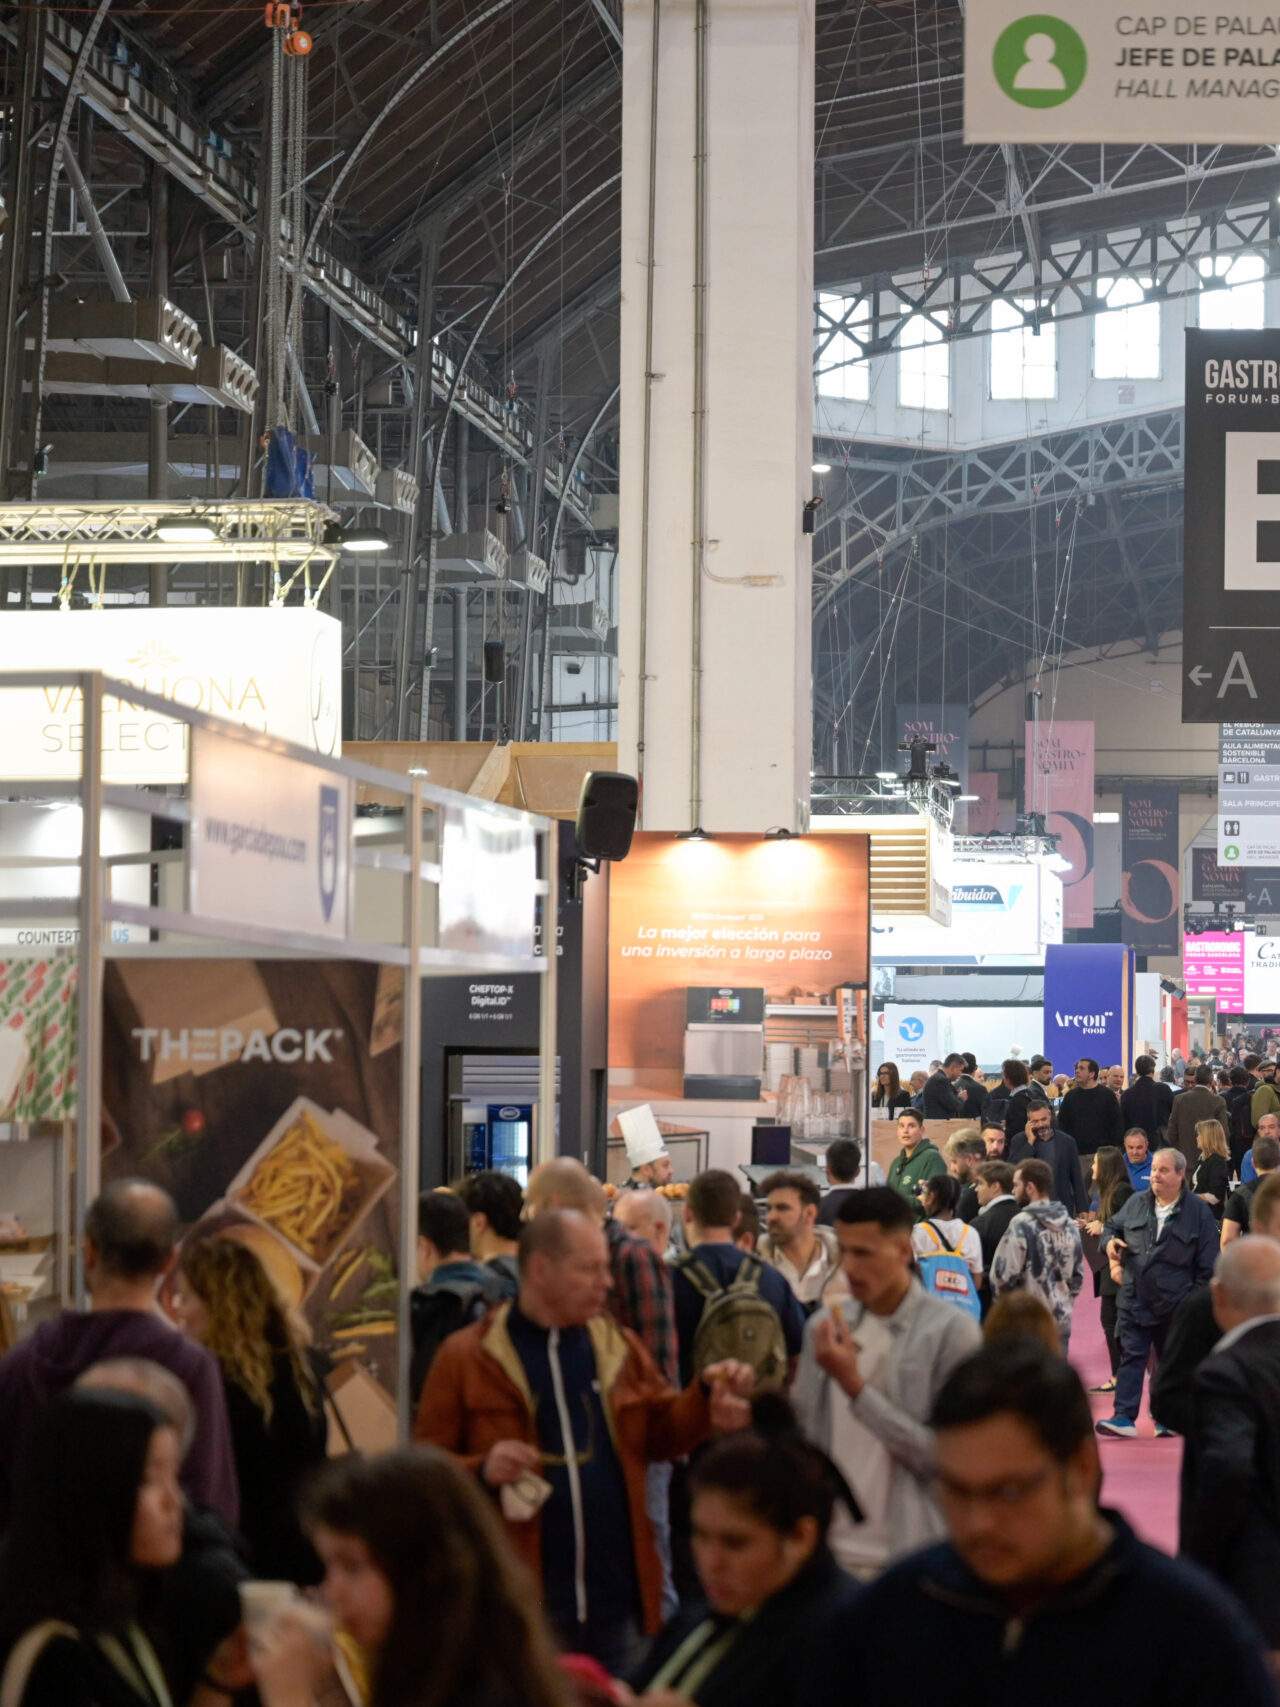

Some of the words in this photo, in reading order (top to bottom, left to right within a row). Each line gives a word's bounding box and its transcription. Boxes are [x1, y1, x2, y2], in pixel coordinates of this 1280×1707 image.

[1115, 16, 1167, 36] CAP
[1174, 16, 1208, 36] DE
[1115, 47, 1175, 67] JEFE
[1182, 48, 1215, 67] DE
[1115, 79, 1178, 98] HALL
[1217, 651, 1258, 699] A
[1257, 888, 1272, 905] A
[637, 926, 657, 939] La
[660, 925, 708, 942] mejor
[711, 926, 779, 941] elección
[783, 930, 821, 943] para
[621, 946, 653, 957] una
[656, 945, 726, 959] inversión
[729, 947, 740, 960] a
[745, 946, 786, 961] largo
[789, 947, 833, 961] plazo
